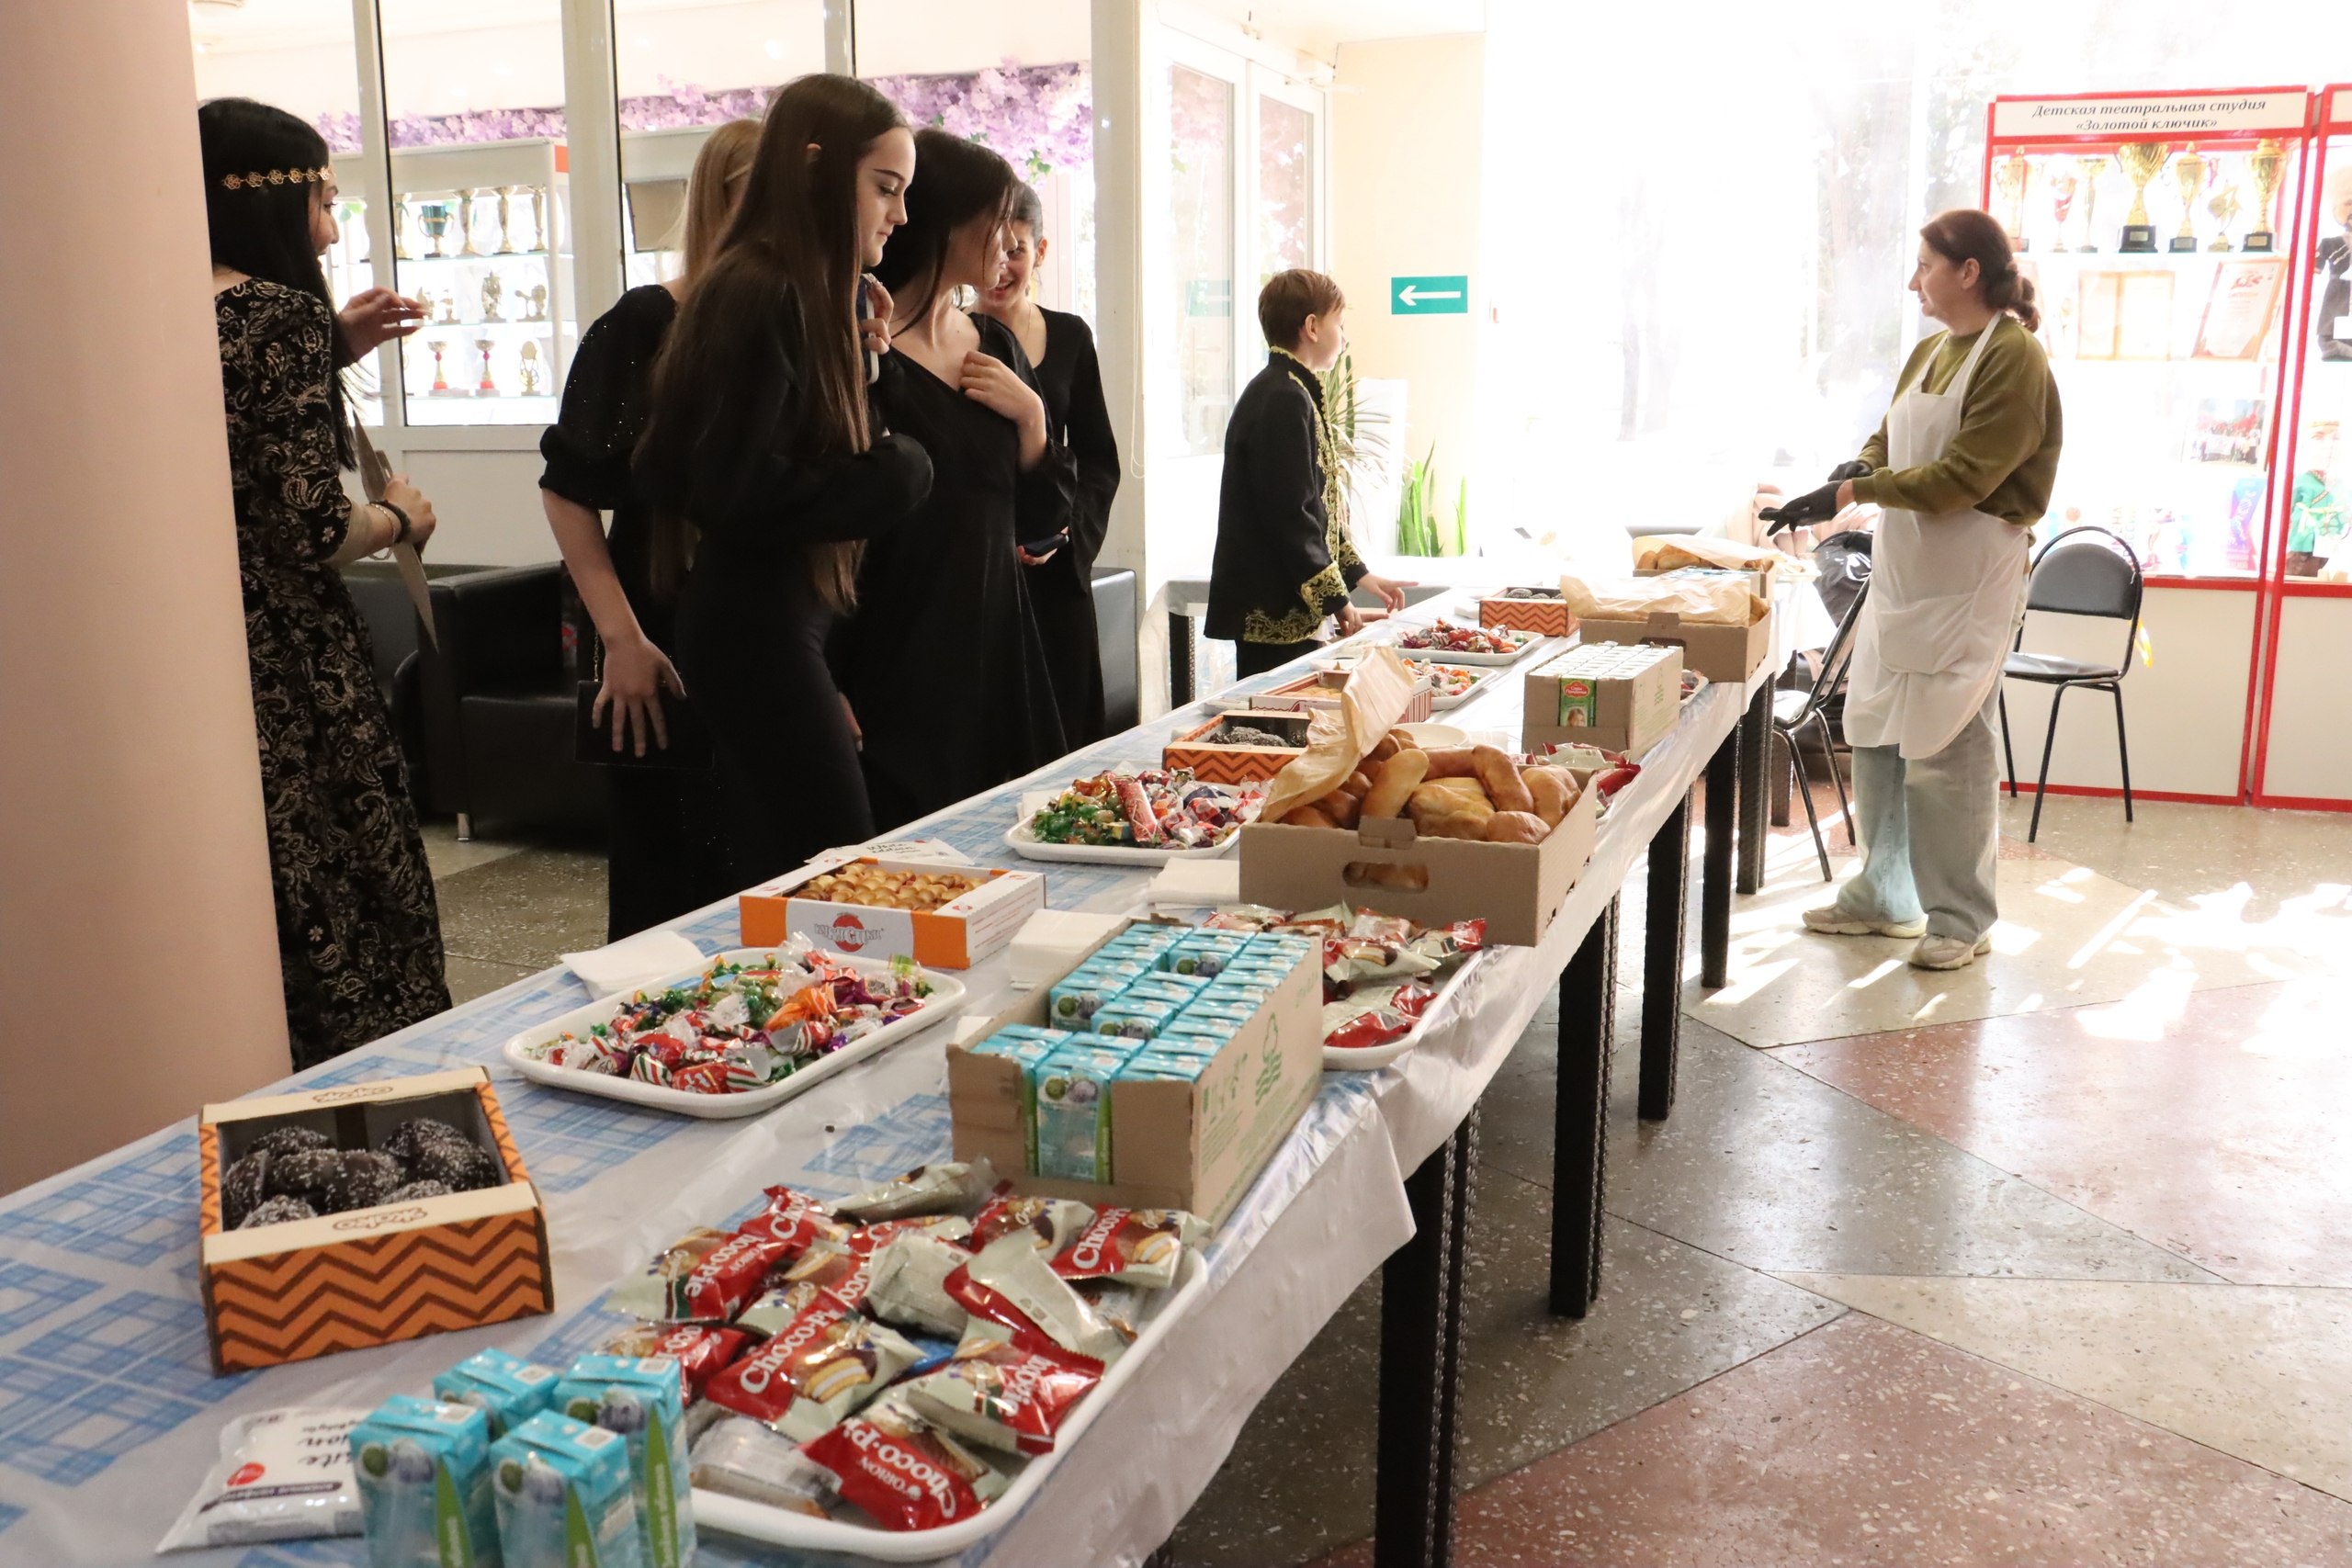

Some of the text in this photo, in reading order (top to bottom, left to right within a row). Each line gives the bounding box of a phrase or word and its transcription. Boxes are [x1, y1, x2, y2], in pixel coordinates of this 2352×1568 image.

[2032, 98, 2267, 118] Детская театральная студия
[2076, 118, 2217, 130] «Золотой ключик»
[860, 1457, 910, 1493] ORION
